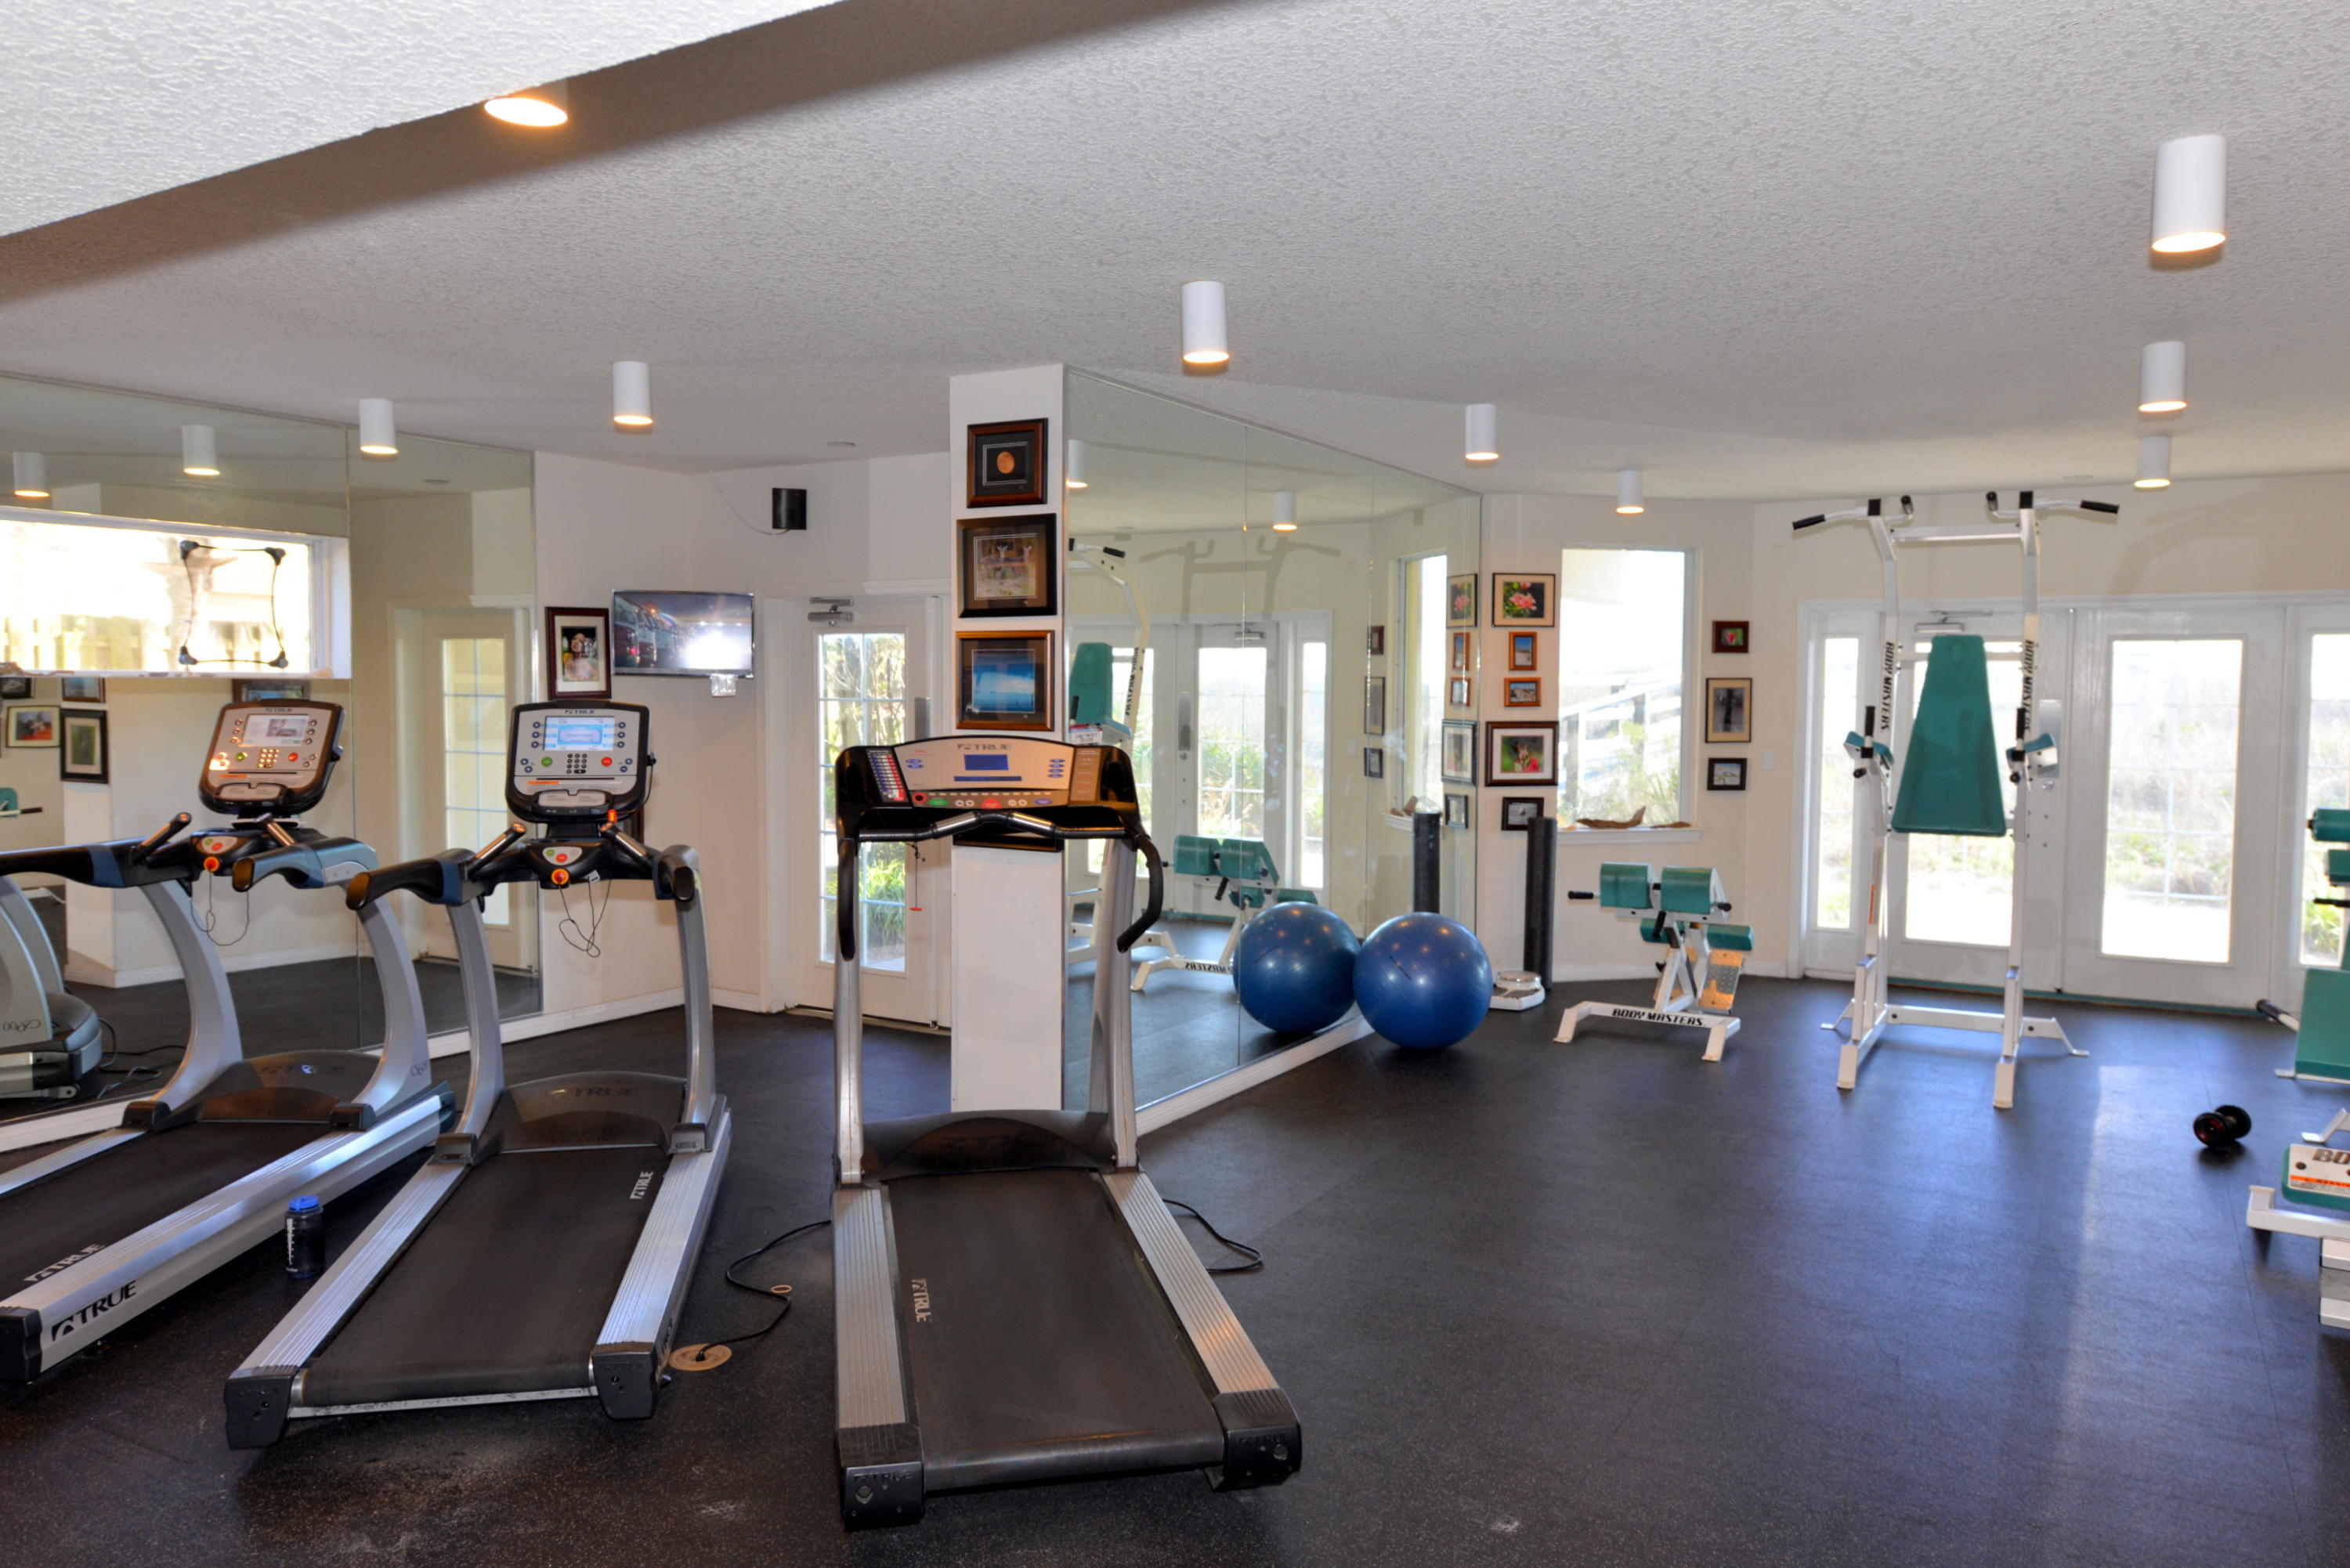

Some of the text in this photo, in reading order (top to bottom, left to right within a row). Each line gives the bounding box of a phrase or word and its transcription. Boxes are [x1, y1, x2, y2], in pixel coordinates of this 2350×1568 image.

[2023, 639, 2034, 674] BODY
[1881, 641, 1895, 732] BODY MASTERS
[1612, 1008, 1704, 1026] BODY MASTERS
[573, 1086, 639, 1097] TRUE
[2312, 1148, 2350, 1165] BO
[633, 1172, 654, 1191] TRUE
[46, 1243, 107, 1270] TRUE
[76, 1280, 137, 1324] TRUE
[913, 1292, 932, 1323] TRUE
